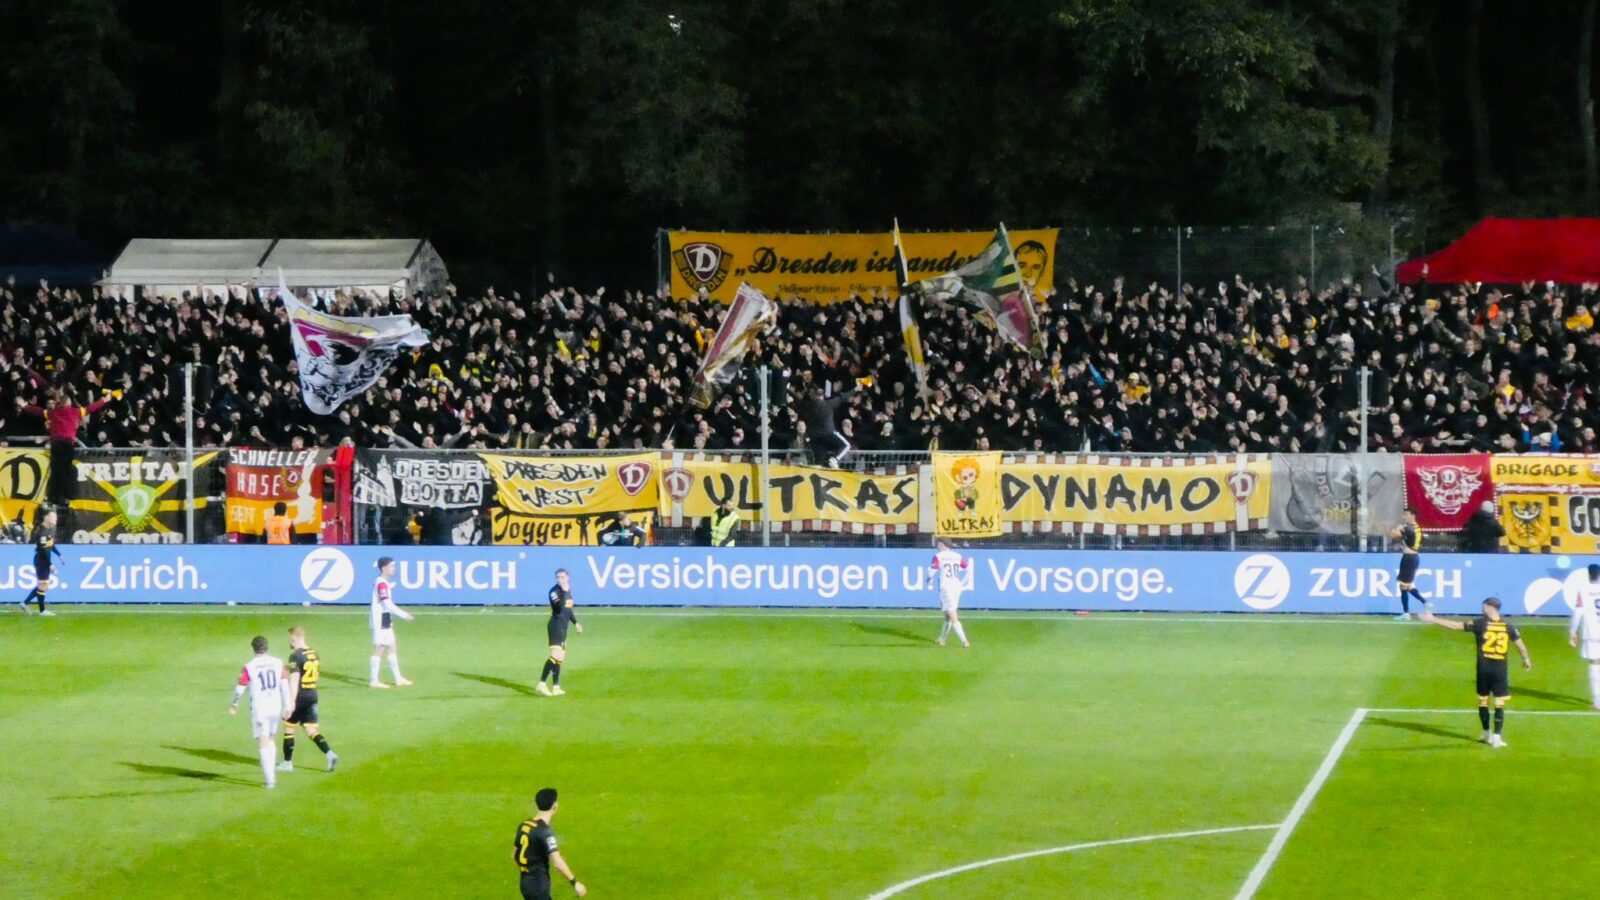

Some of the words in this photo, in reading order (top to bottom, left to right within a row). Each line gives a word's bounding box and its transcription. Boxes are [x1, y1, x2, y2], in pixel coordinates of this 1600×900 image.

[681, 268, 727, 293] DREDEN
[229, 449, 319, 467] SCHNELLER
[395, 459, 491, 481] DRESDEN
[501, 460, 608, 482] DRESDEN
[1495, 463, 1578, 477] BRIGADE
[237, 472, 281, 496] HASE
[703, 472, 915, 516] ULTRAS
[1000, 472, 1221, 513] DYNAMO
[518, 486, 596, 508] WEST
[494, 508, 572, 546] Jogger
[80, 555, 208, 591] Zurich.
[586, 554, 889, 598] Versicherungen
[902, 557, 975, 592] ud
[987, 557, 1174, 601] Vorsorge.
[1481, 631, 1509, 654] 23
[258, 669, 277, 691] 10
